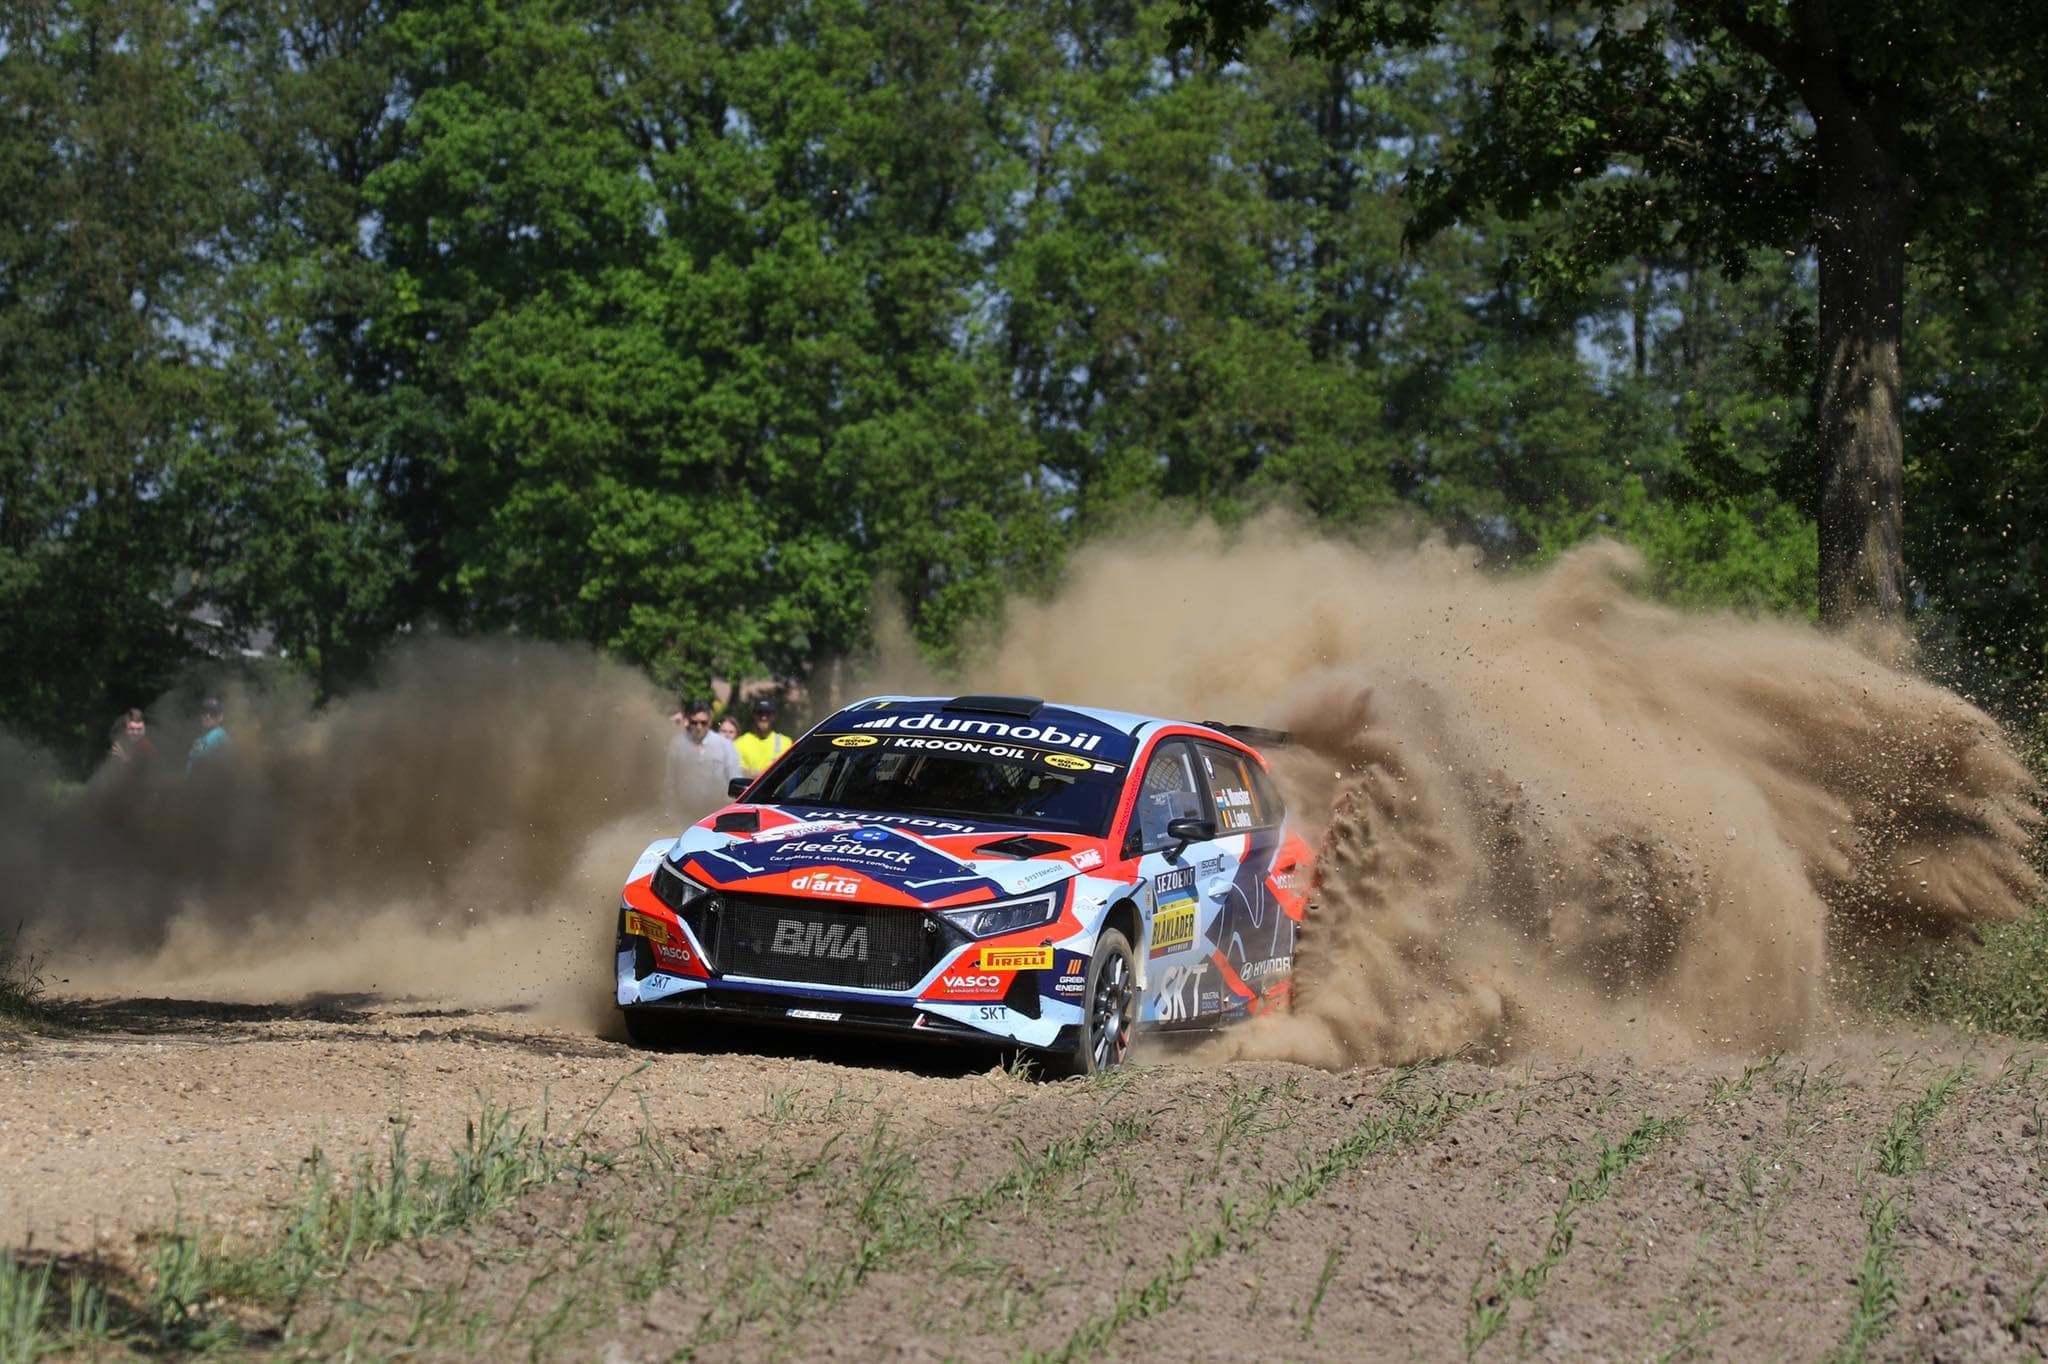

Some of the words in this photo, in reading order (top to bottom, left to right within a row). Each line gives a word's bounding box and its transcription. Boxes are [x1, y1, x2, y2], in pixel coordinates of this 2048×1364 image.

[899, 713, 1103, 751] dumobil
[894, 737, 1026, 760] KROON-OIL
[1049, 757, 1086, 767] KROON
[805, 811, 976, 833] HYUNDAI
[776, 841, 917, 865] Fleetback
[822, 856, 864, 864] customers
[865, 860, 908, 872] connected
[1156, 868, 1194, 894] SEZOENS
[629, 916, 664, 938] PIRELLI
[770, 919, 869, 961] BMA
[655, 944, 691, 961] VASCO
[987, 951, 1046, 967] PIRELLI
[651, 975, 671, 989] SKT
[943, 976, 1000, 987] VASCO
[1158, 962, 1209, 1025] SKT
[980, 1007, 1008, 1020] SKT
